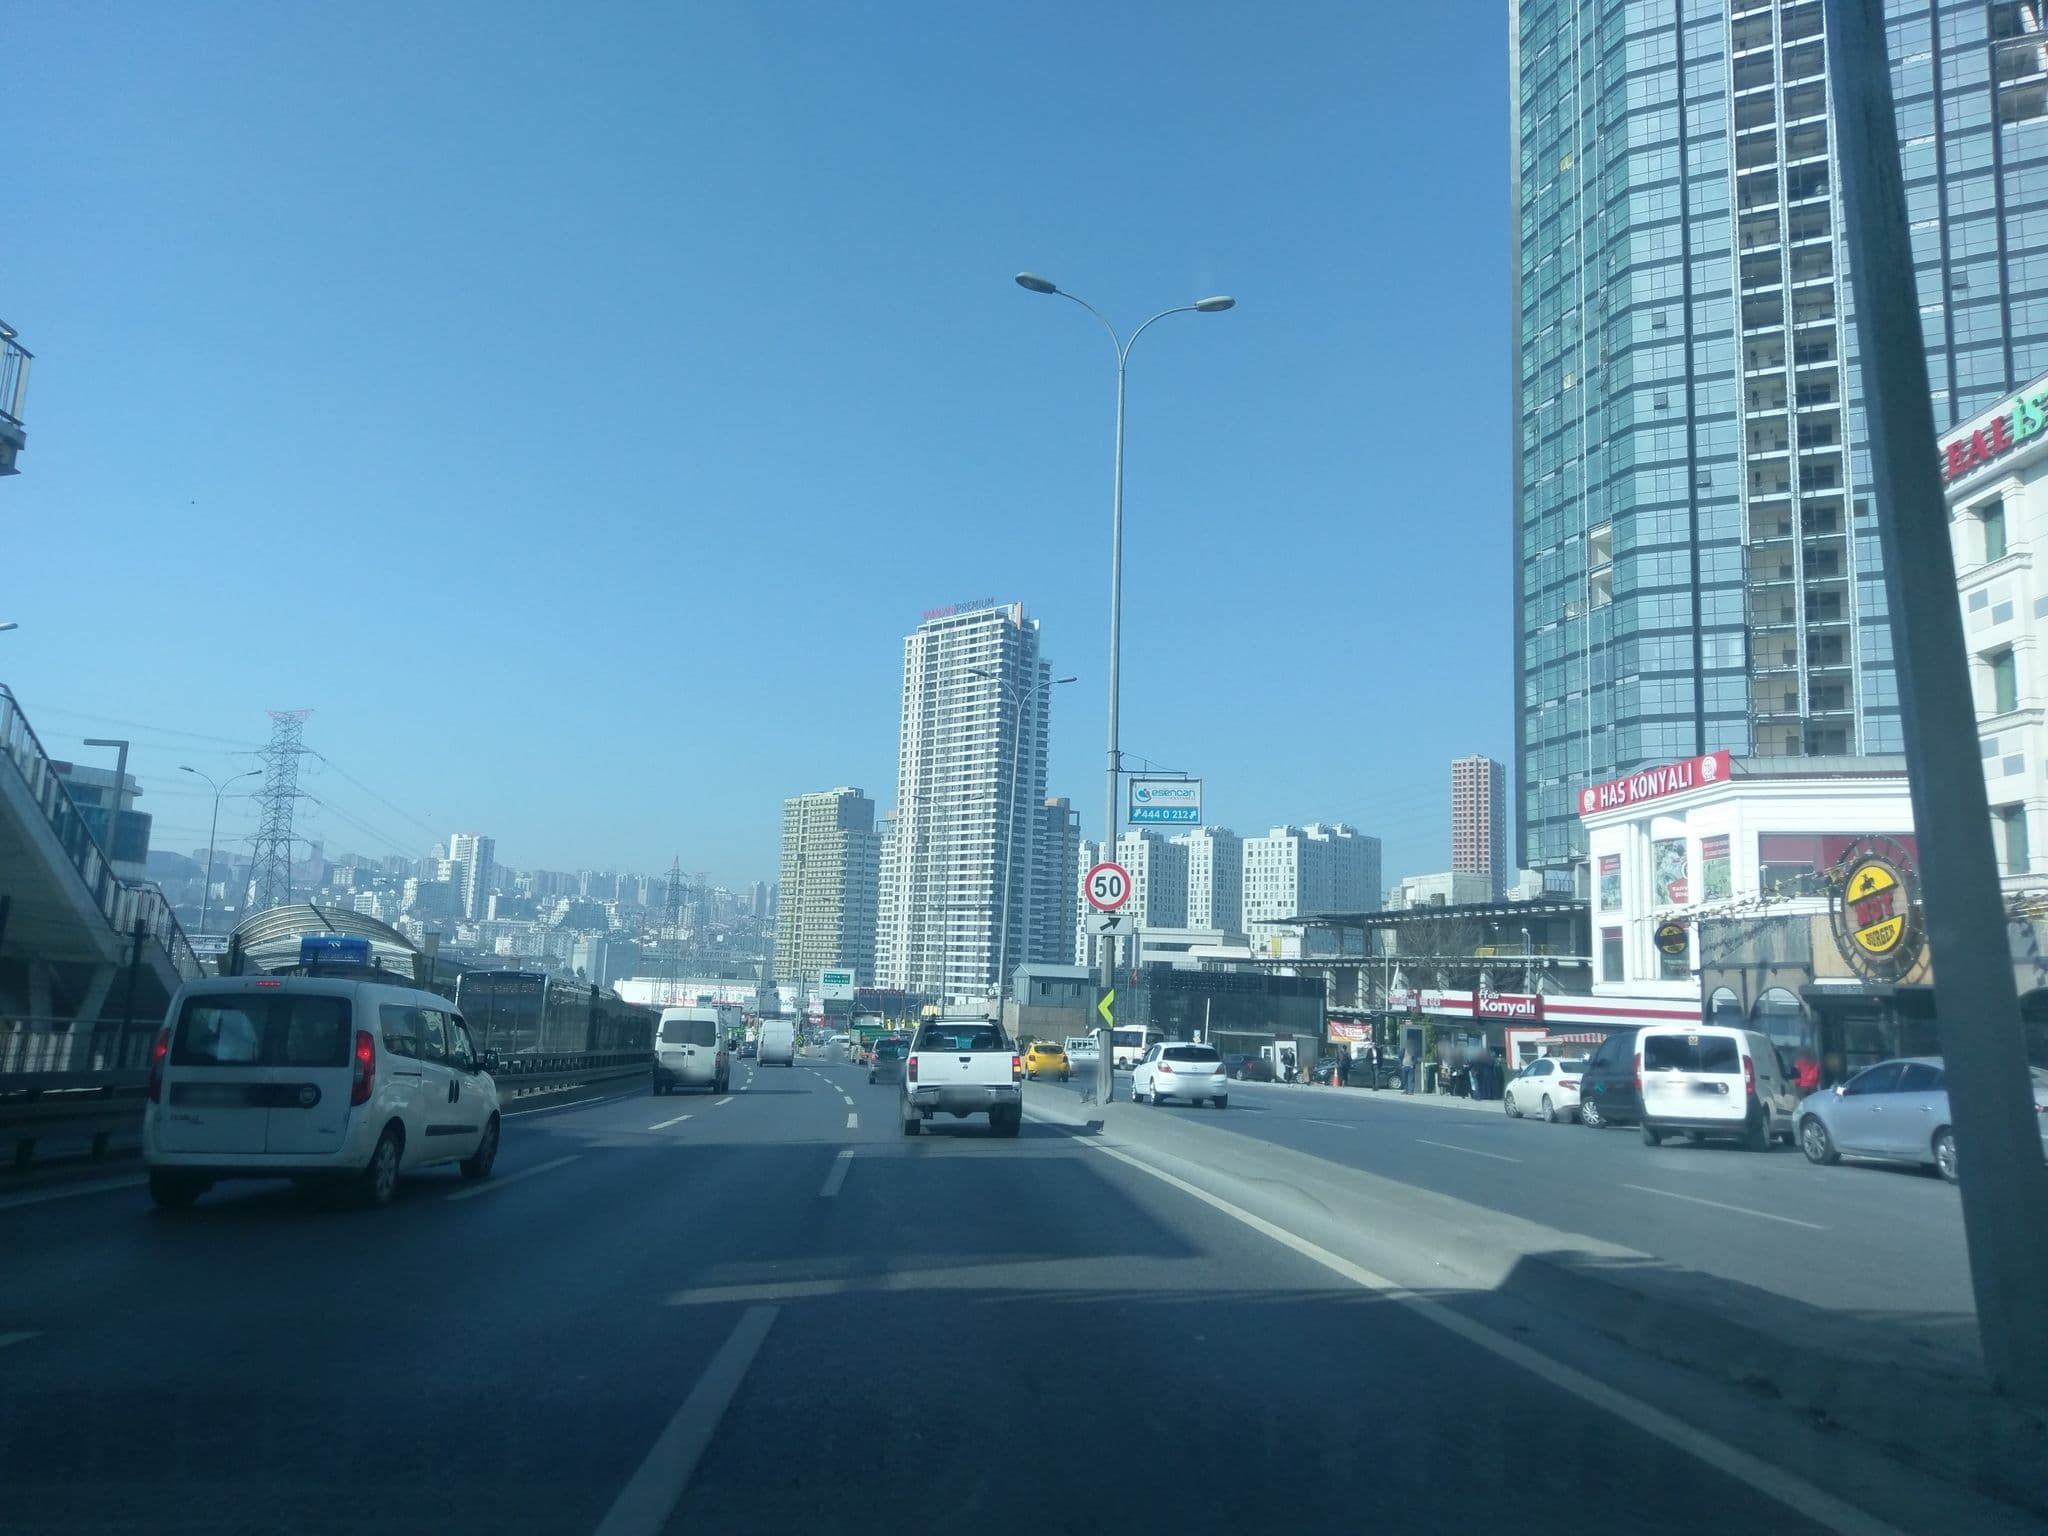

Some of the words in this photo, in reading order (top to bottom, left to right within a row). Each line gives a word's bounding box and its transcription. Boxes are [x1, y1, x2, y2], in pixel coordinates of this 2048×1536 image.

[955, 597, 995, 613] PREMIUM
[1151, 788, 1196, 797] esencan
[1600, 781, 1626, 808] HAS
[1630, 762, 1693, 801] KONYALI
[1141, 809, 1161, 819] 444
[1163, 809, 1170, 819] 0
[1172, 809, 1189, 819] 212
[1094, 875, 1122, 898] 50
[1865, 924, 1896, 947] BURGER
[1479, 999, 1536, 1017] Konyalı
